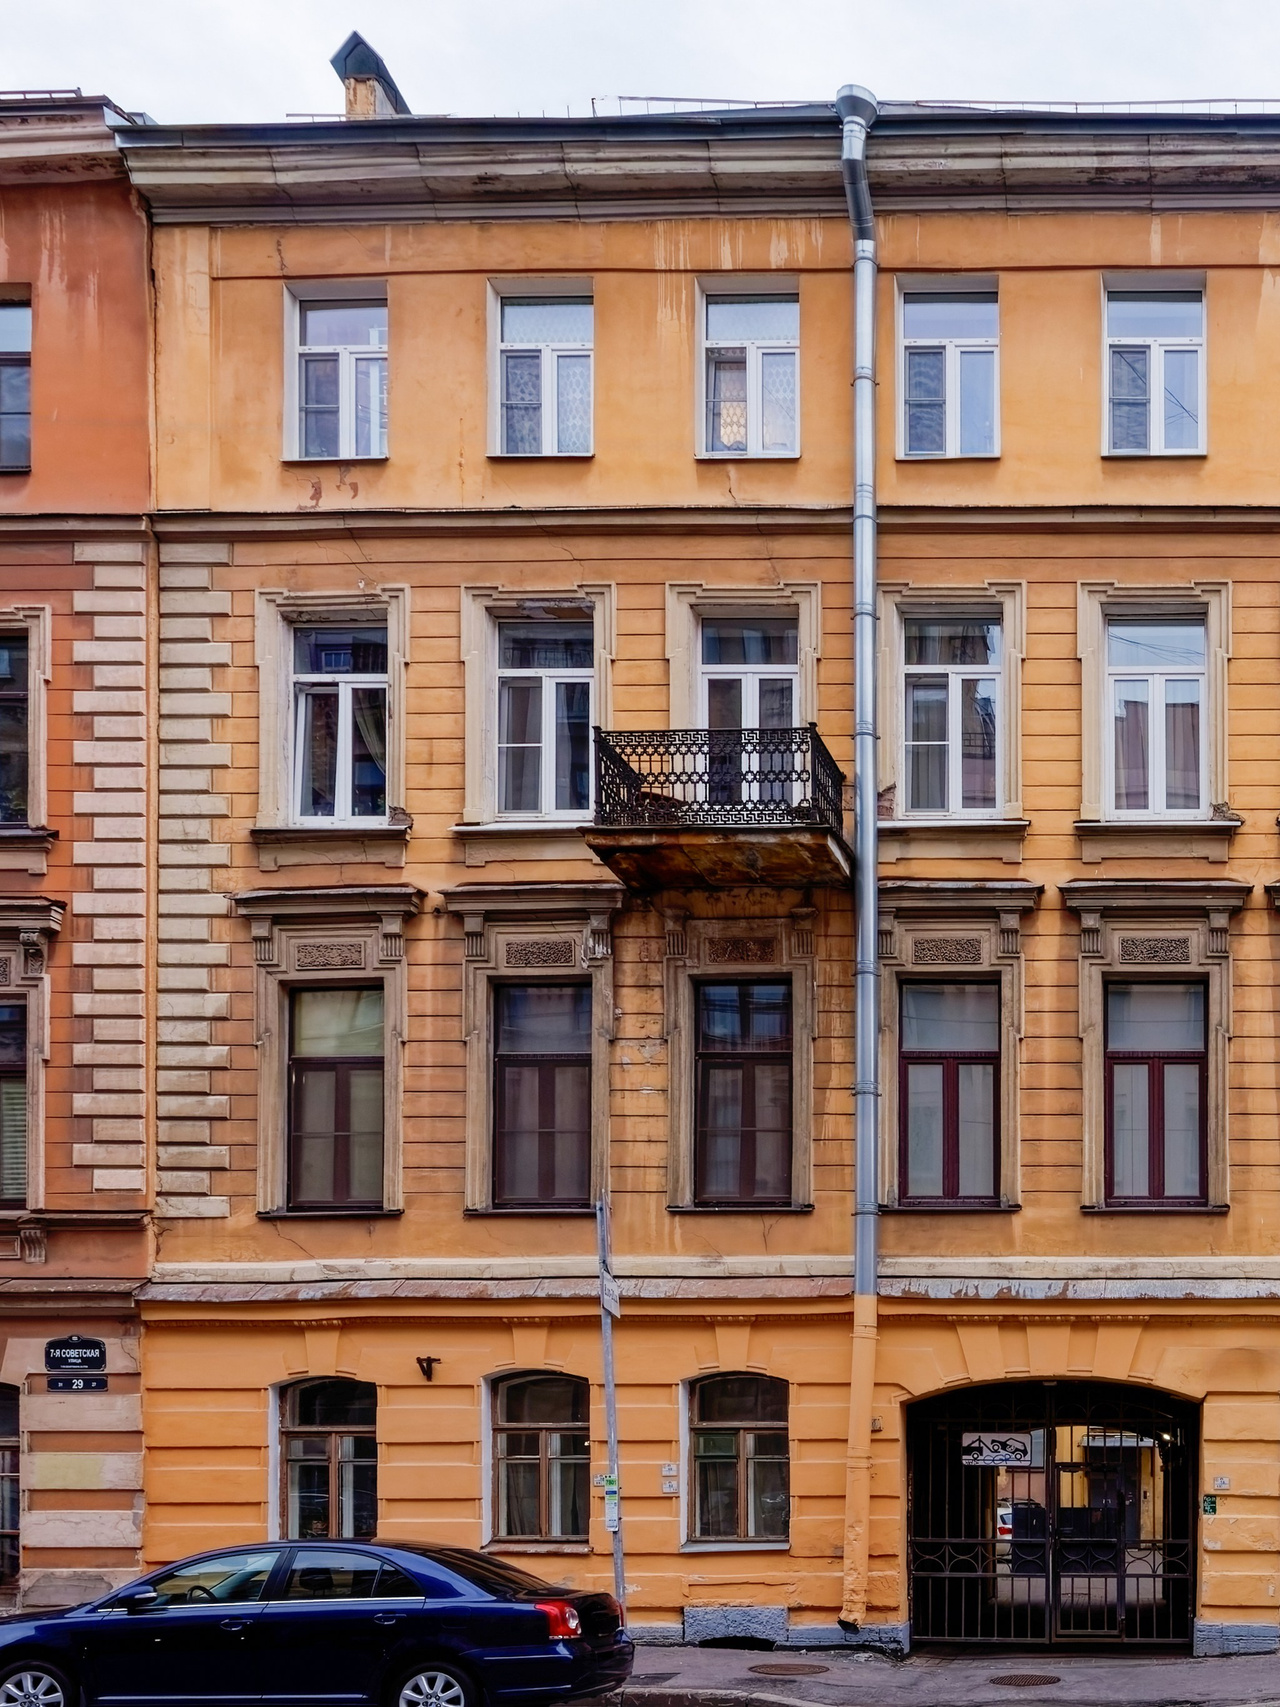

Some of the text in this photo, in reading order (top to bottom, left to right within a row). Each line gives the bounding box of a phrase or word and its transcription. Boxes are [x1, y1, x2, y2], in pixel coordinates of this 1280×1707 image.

[50, 1349, 100, 1358] 7-Я СОВЕТСКАЯ
[72, 1379, 84, 1389] 29
